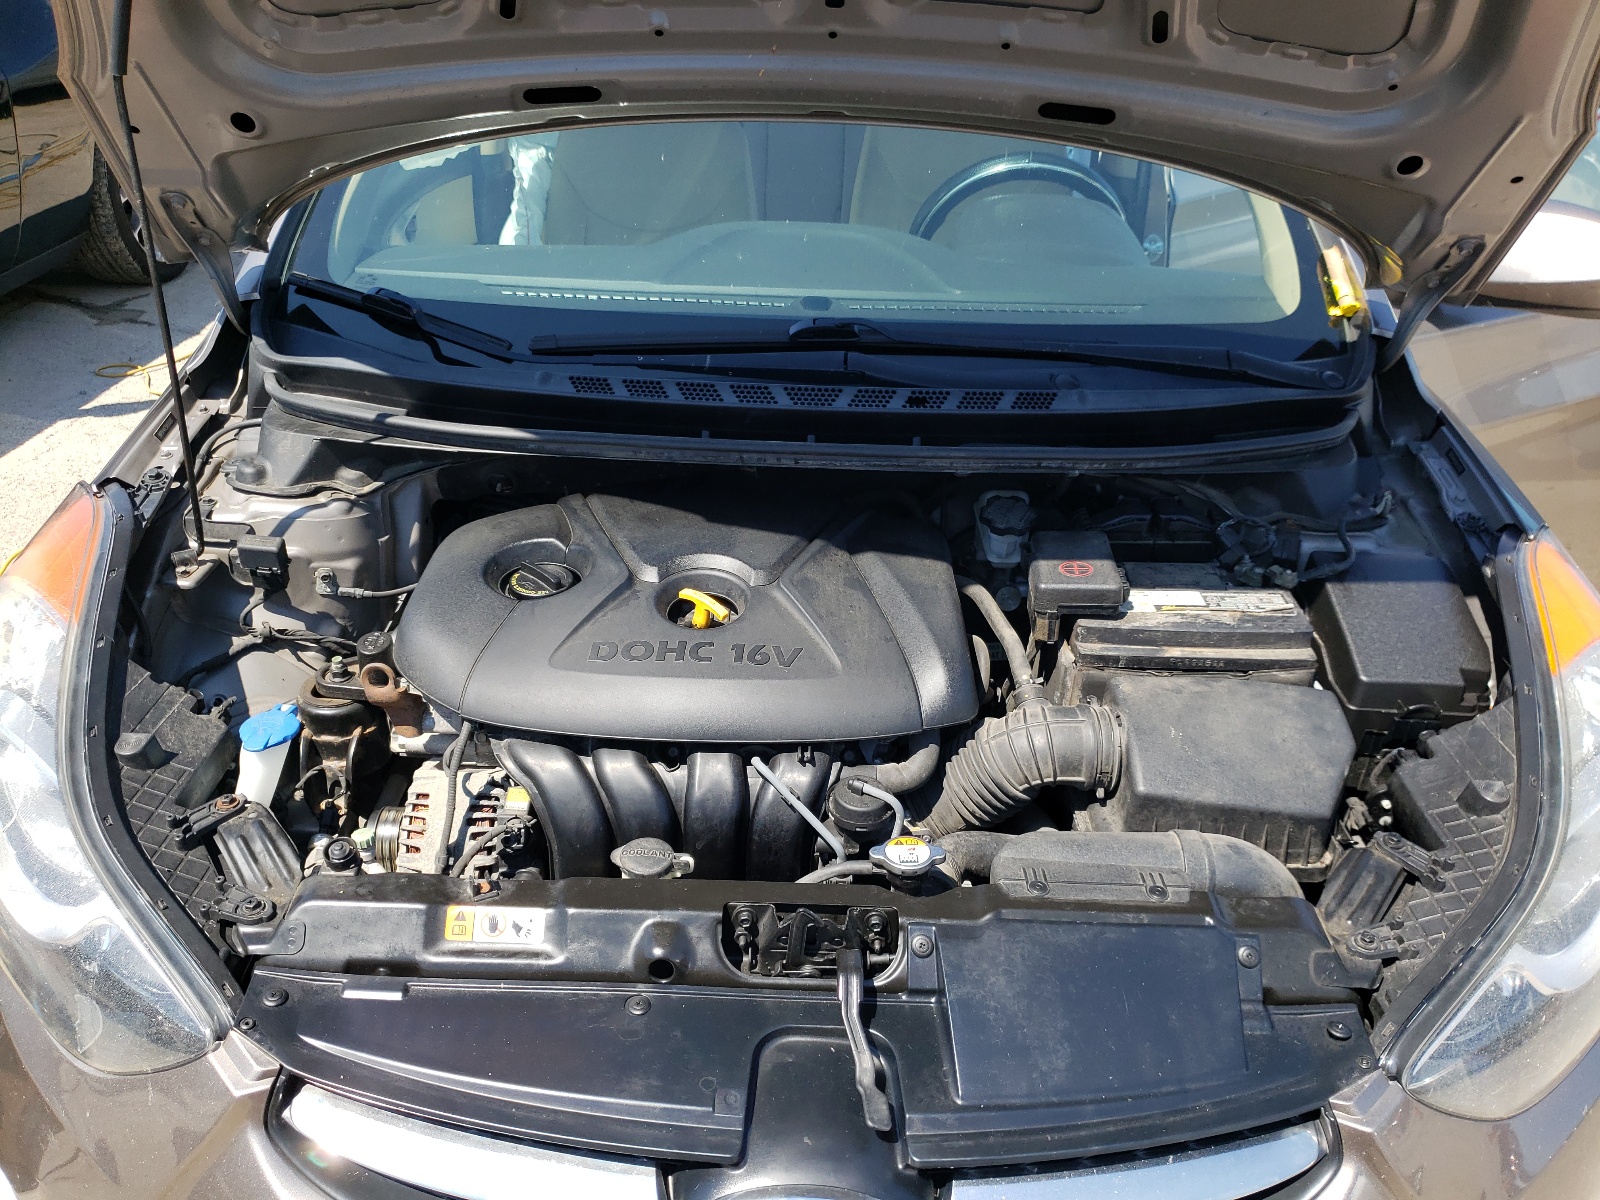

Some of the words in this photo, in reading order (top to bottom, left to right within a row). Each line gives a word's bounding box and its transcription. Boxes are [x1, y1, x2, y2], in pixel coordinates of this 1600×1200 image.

[587, 640, 715, 663] DOHC
[730, 643, 804, 668] 16V
[621, 848, 673, 859] COOLANT
